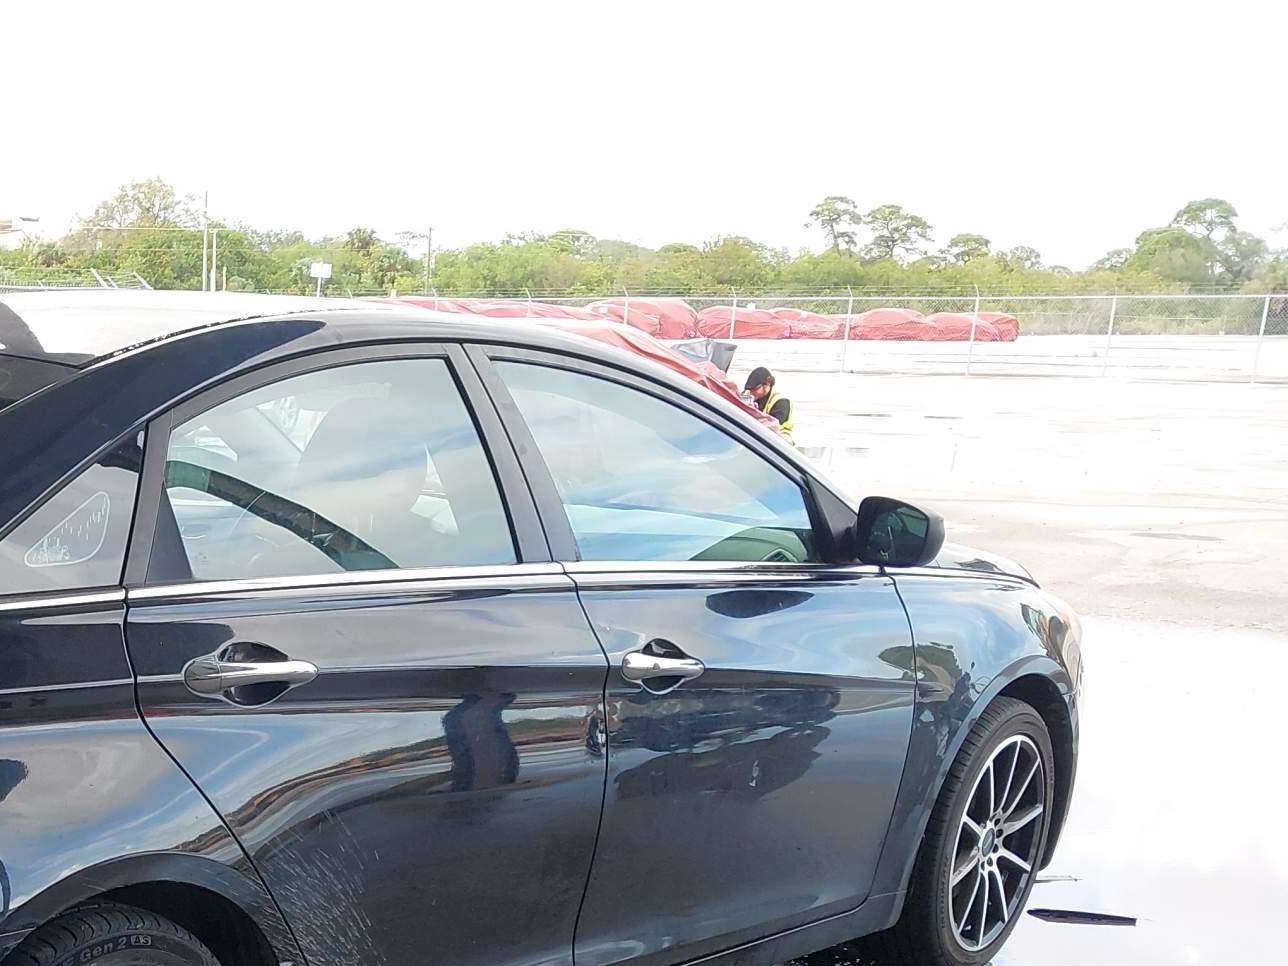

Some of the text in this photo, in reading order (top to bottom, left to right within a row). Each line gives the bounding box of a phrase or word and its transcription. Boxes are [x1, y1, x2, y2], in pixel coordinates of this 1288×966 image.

[80, 942, 113, 962] Gen
[117, 936, 127, 950] 2
[132, 935, 152, 946] AS
